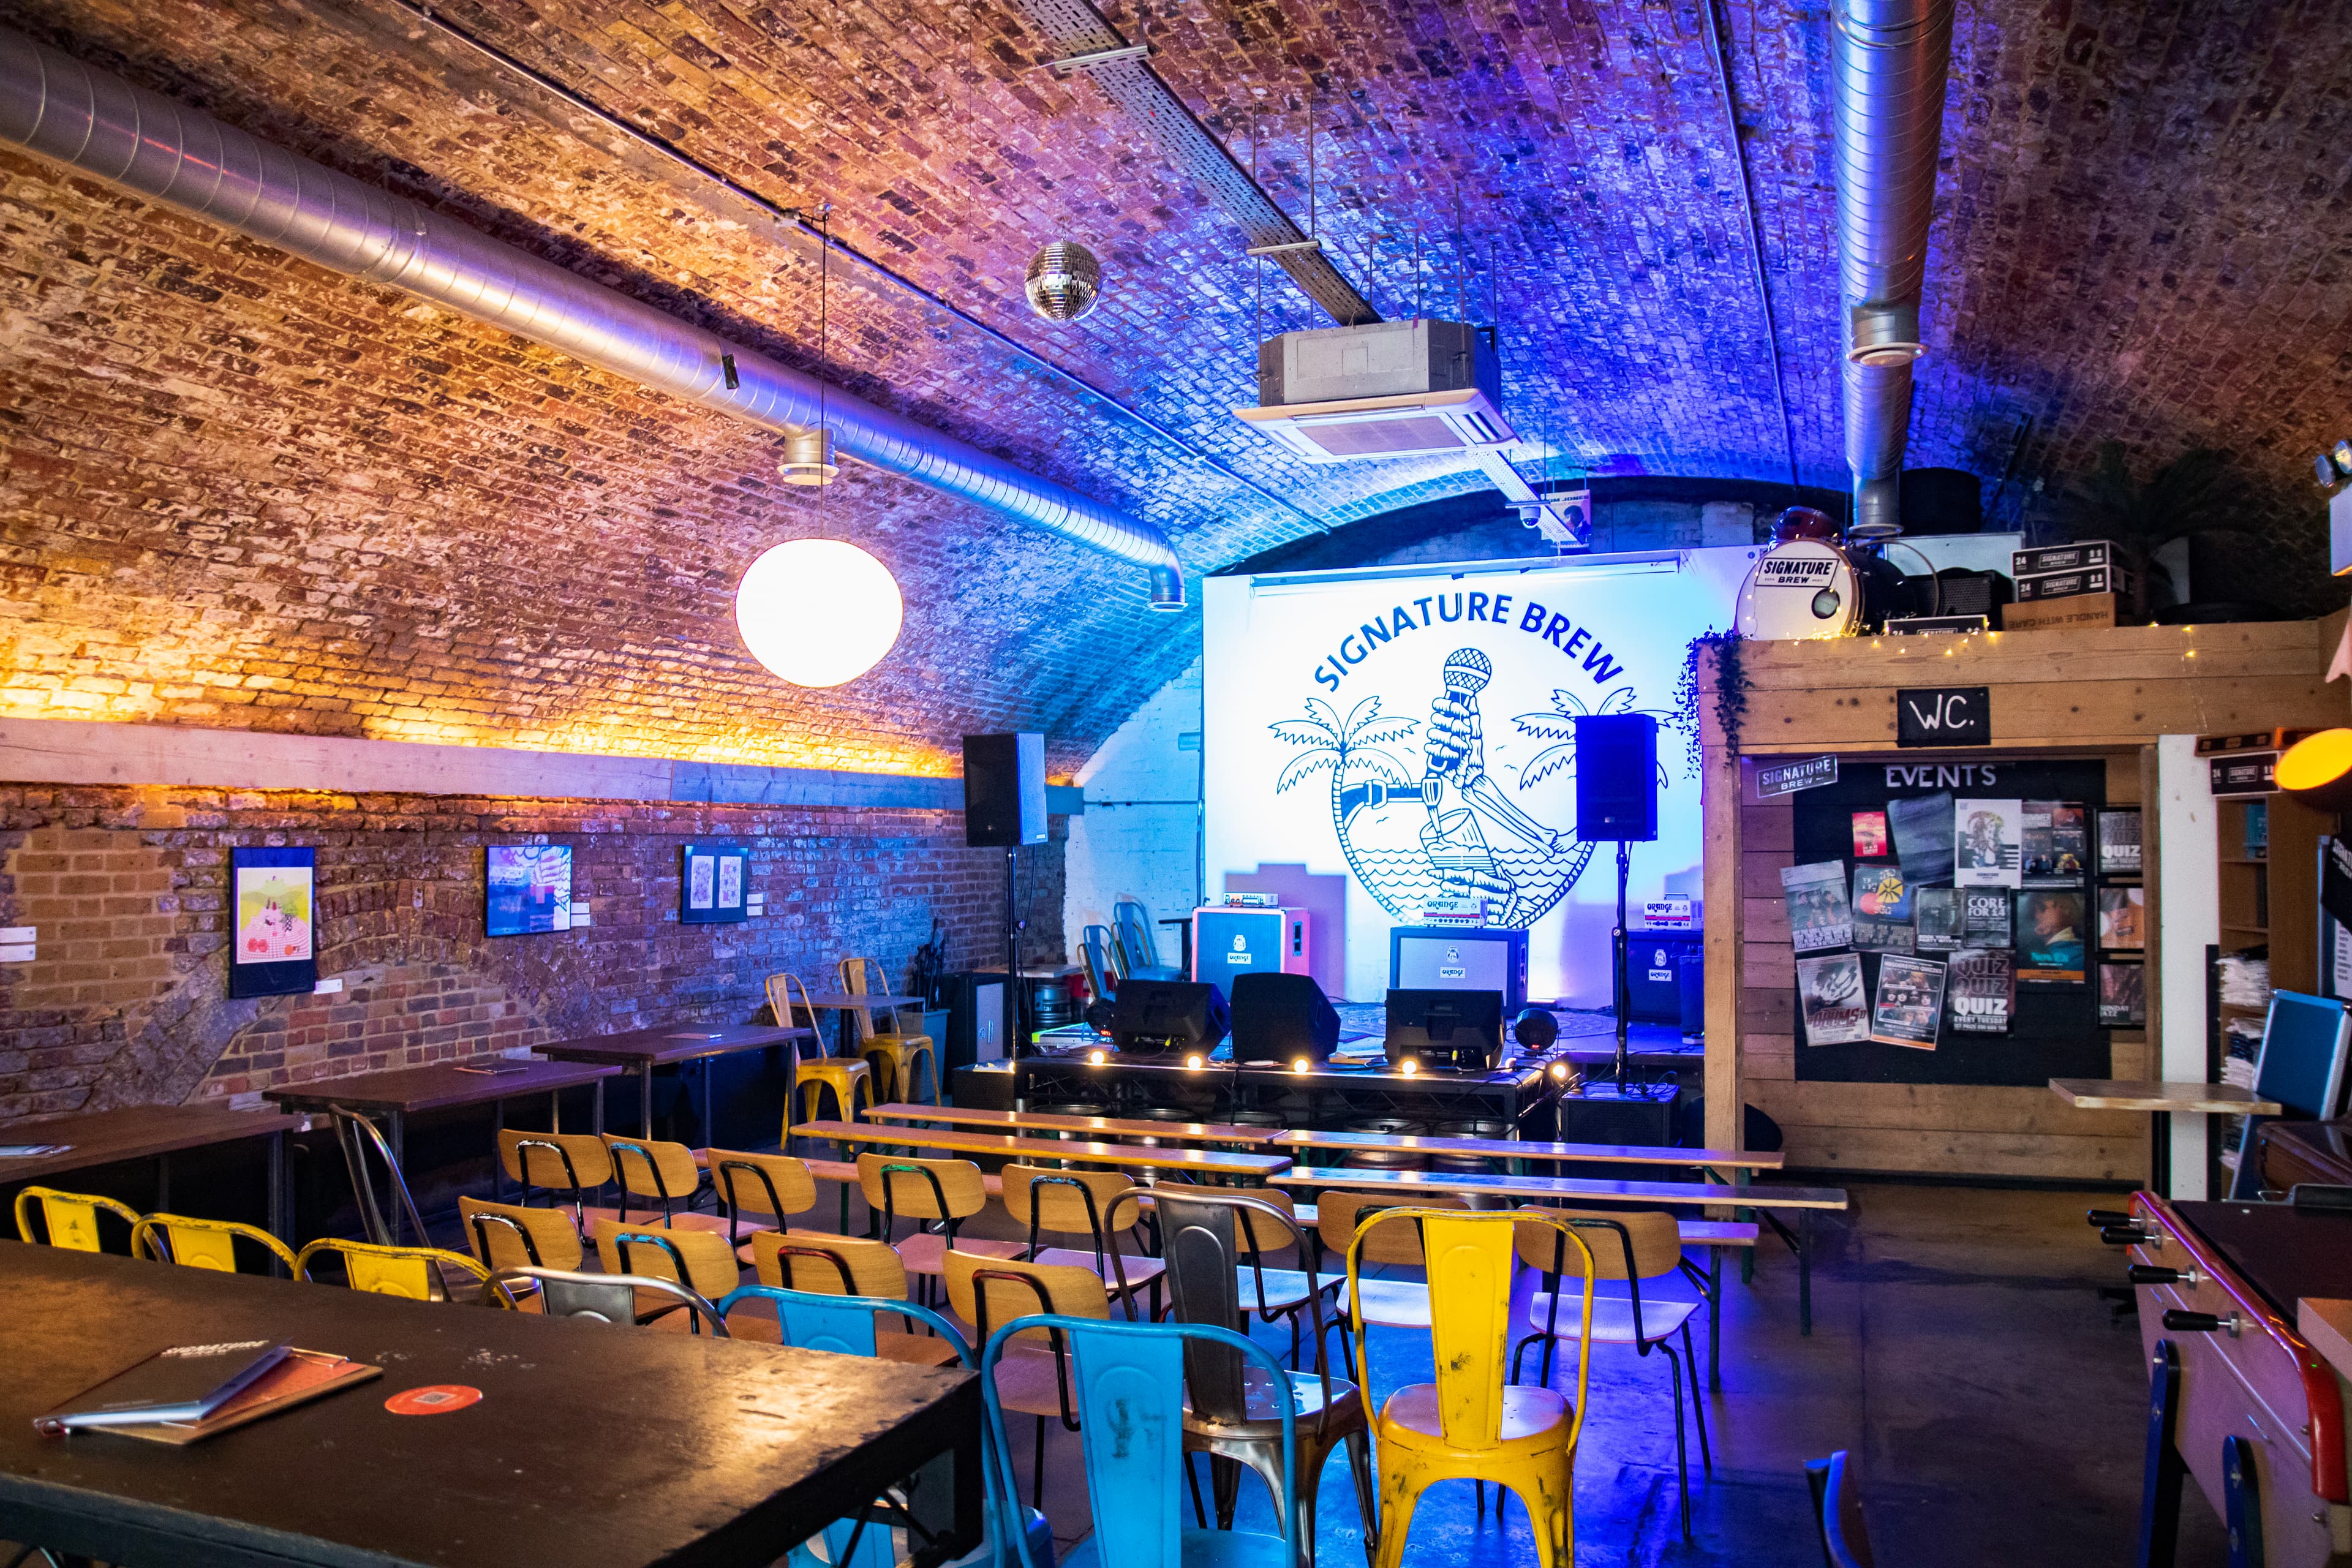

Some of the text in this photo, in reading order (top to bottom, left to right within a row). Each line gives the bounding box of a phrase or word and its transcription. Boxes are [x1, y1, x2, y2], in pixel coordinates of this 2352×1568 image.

[2041, 552, 2076, 562] SIGNATURE
[1763, 560, 1833, 575] SIGNATURE
[2020, 578, 2078, 592] 24 SIGNATURE
[2008, 611, 2109, 629] HANDLE WITH CARE
[1314, 592, 1624, 692] SIGNATURE BREW
[1762, 759, 1831, 786] SIGNATURE
[1886, 764, 1997, 788] EVENTS
[2213, 768, 2221, 778] 24
[1781, 777, 1813, 790] BREW
[2101, 845, 2141, 859] QUIZ
[1427, 900, 1458, 911] ORANGE
[1646, 903, 1673, 913] ORANGE
[1967, 897, 2006, 908] CORE
[1967, 908, 2006, 917] FOR £4
[1955, 957, 2010, 976] QUIZ
[1954, 976, 2010, 997] QUIZ
[1954, 997, 2008, 1016] QUIZ
